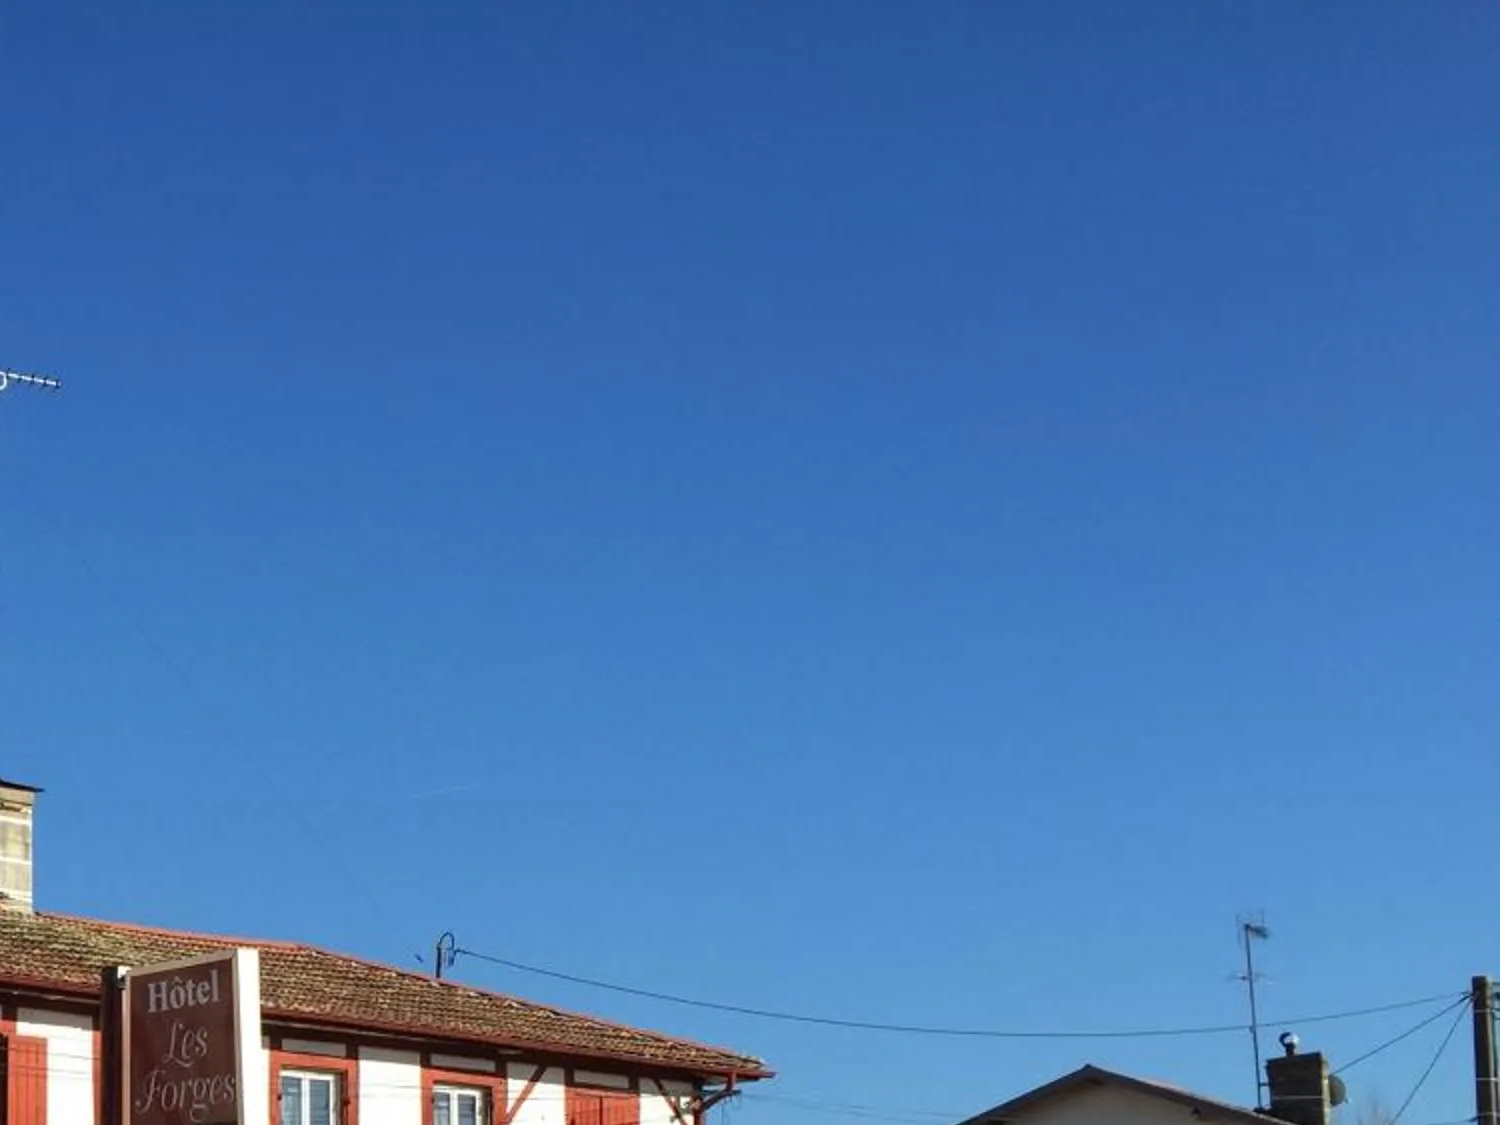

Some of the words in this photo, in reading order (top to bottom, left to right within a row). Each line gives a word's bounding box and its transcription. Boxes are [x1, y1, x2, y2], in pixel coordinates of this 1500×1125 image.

[148, 969, 220, 1013] Hôtel
[162, 1020, 209, 1068] Les
[134, 1066, 236, 1123] Forges
